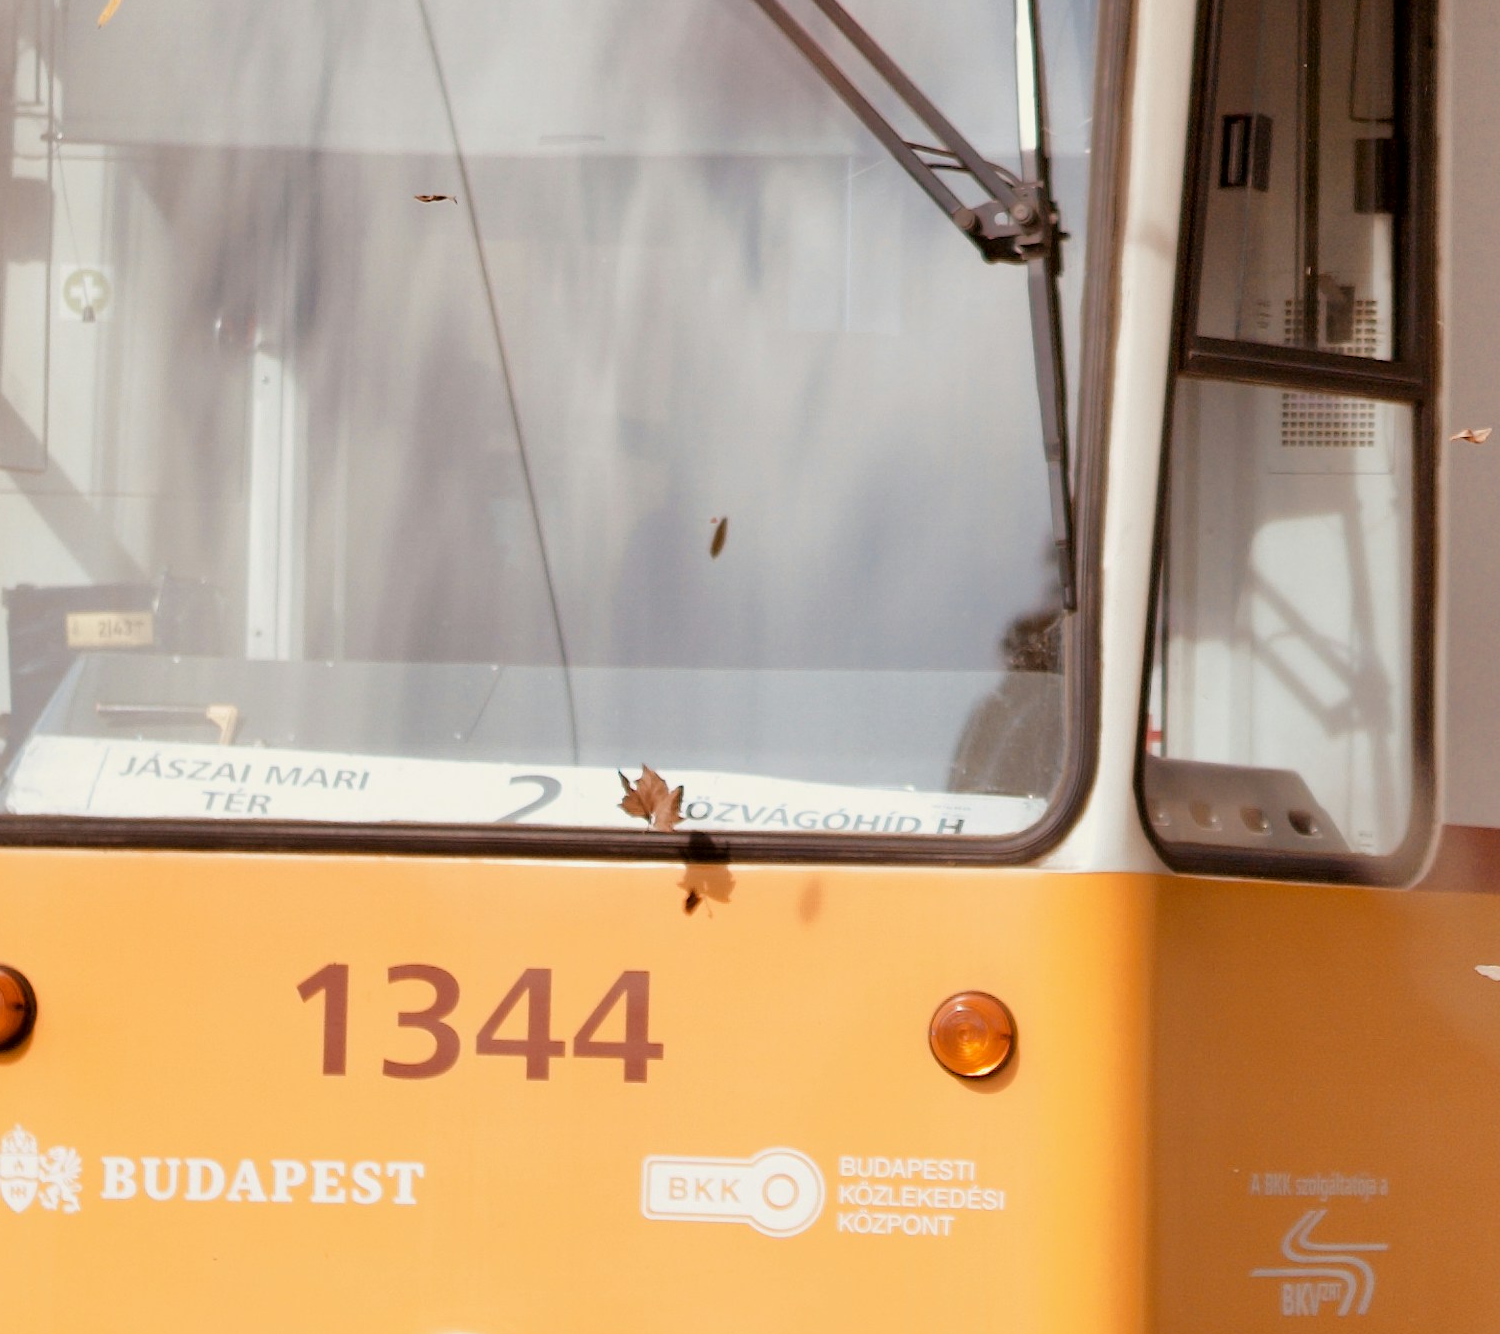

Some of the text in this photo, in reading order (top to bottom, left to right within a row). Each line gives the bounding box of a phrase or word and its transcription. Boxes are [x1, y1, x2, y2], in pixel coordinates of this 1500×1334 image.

[119, 753, 370, 792] JÁSZAI MARI
[203, 788, 273, 815] TÉR
[493, 774, 563, 823] 2
[686, 796, 922, 835] ÖZVÁGÓHÍD
[296, 963, 664, 1083] 1344
[100, 1156, 425, 1205] BUDAPEST
[838, 1155, 975, 1181] BUDAPESTI
[668, 1176, 741, 1204] BKK
[838, 1181, 1006, 1211] KÖZLEKEDÉSI
[837, 1211, 955, 1236] KÖZPONT
